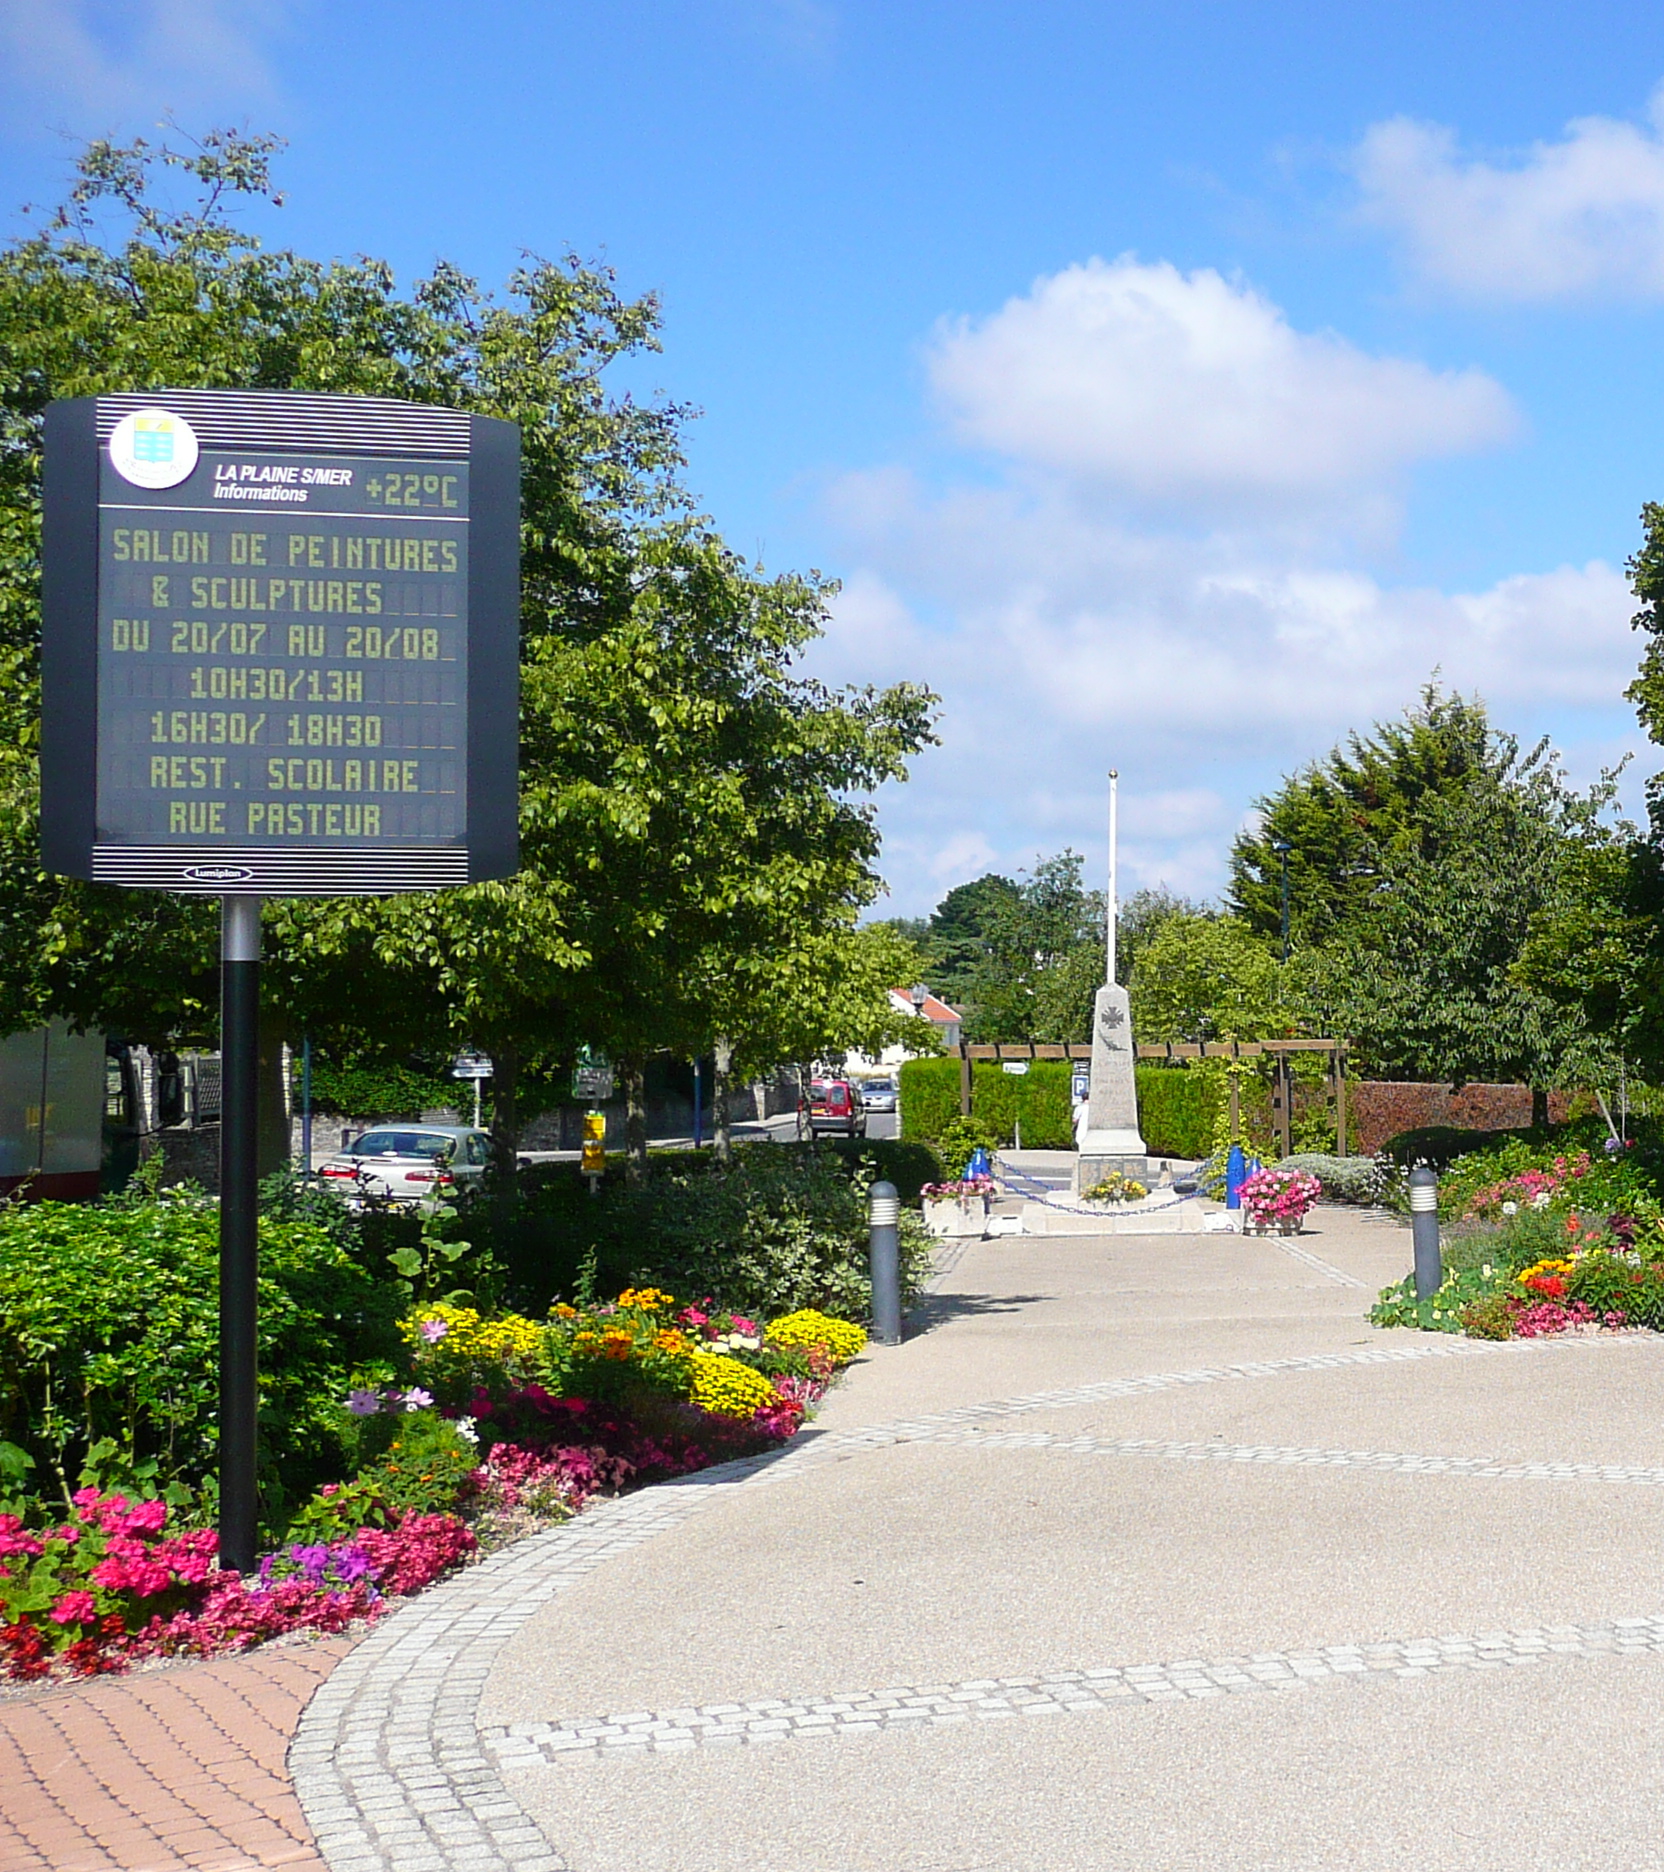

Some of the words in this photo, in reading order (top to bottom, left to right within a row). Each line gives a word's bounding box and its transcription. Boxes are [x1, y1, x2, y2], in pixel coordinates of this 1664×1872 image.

[215, 464, 239, 482] LA
[241, 465, 298, 484] PLAINE
[300, 467, 353, 486] S/MER
[213, 485, 308, 502] Informations
[113, 528, 209, 565] SALON
[231, 533, 267, 567] DE
[289, 534, 458, 572] PEINTURES
[152, 576, 168, 607] &
[192, 577, 382, 613] SCULPTURES
[112, 619, 149, 652] DU
[172, 621, 266, 654] 20/07
[289, 625, 325, 657] AU
[346, 626, 439, 658] 20/08
[190, 667, 363, 702] 10H30/13H
[151, 711, 265, 745] 16H30/
[287, 714, 381, 746] 18H30
[151, 756, 241, 789] REST.
[268, 759, 418, 792] SCOLAIRE
[169, 801, 226, 833] RUE
[248, 804, 381, 836] PASTEUR
[195, 867, 242, 879] Lumiplan
[1076, 1082, 1084, 1094] P
